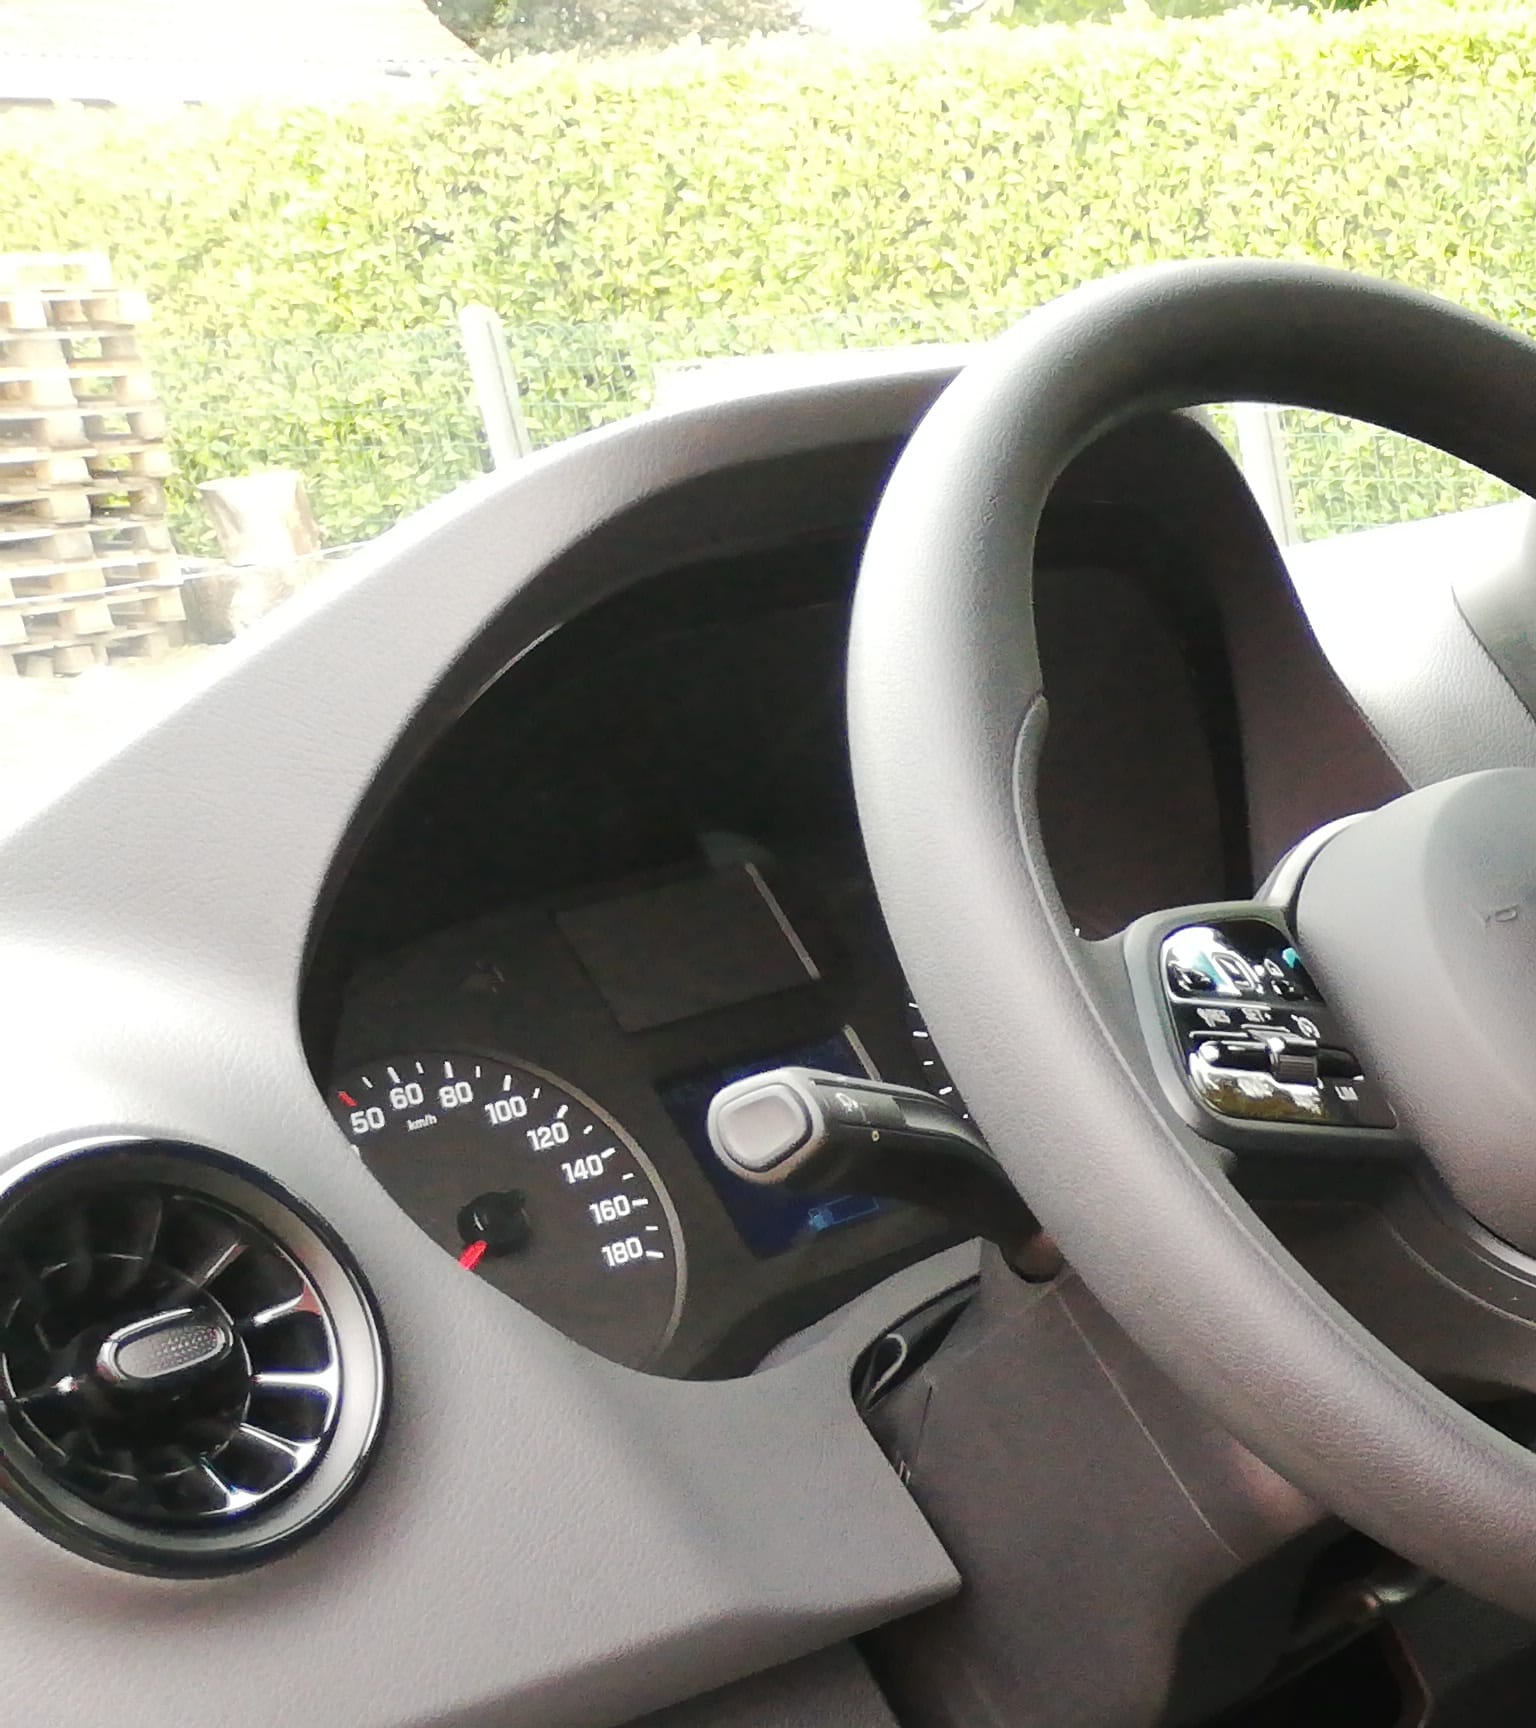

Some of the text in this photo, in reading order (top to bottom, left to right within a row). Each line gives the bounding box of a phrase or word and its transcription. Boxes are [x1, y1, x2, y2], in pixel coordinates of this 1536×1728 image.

[389, 1082, 425, 1111] 60
[438, 1081, 474, 1110] 80
[484, 1095, 528, 1126] 100
[350, 1107, 386, 1135] 50
[406, 1114, 438, 1132] km/h
[527, 1121, 570, 1152] 120
[561, 1153, 604, 1184] 140
[589, 1194, 632, 1225] 160
[602, 1236, 644, 1268] 180
